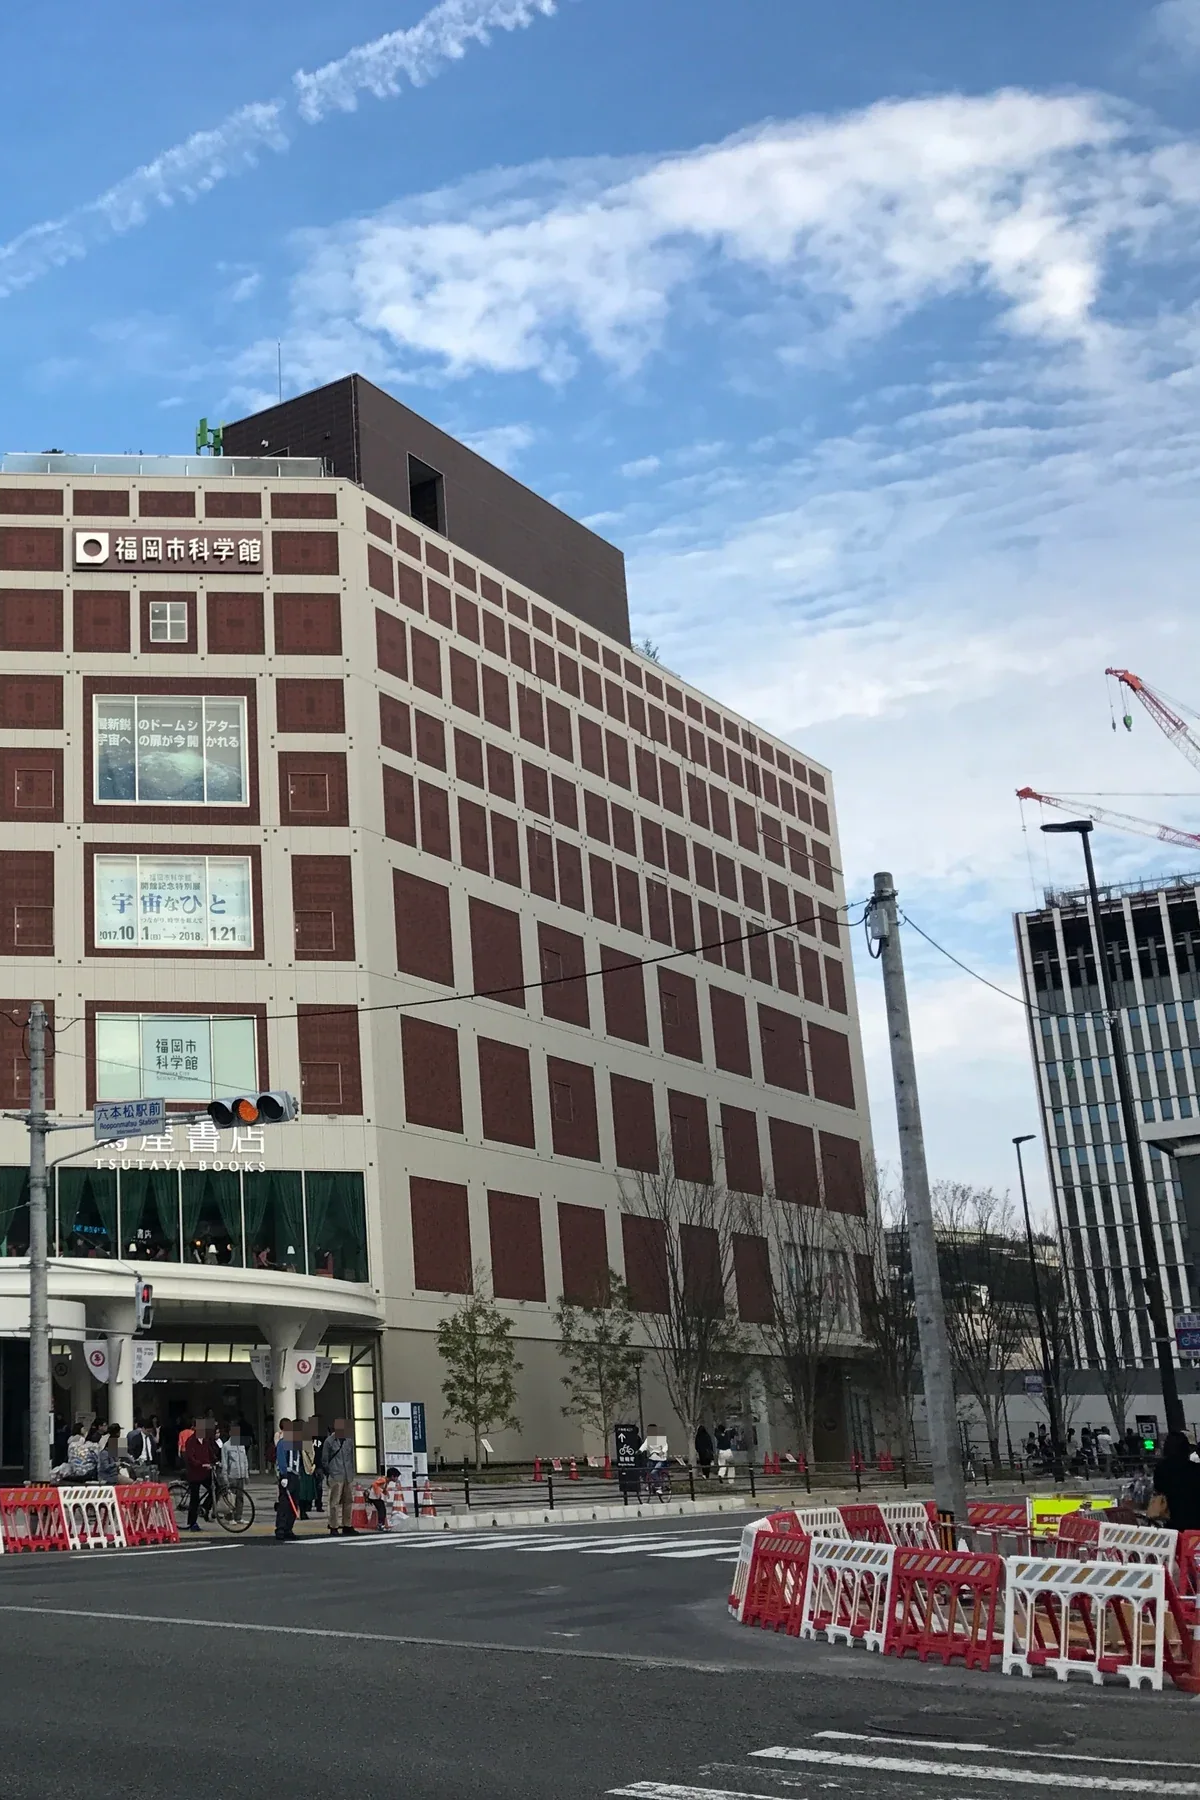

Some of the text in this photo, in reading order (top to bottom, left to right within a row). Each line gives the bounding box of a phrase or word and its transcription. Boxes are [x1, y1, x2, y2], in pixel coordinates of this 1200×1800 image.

[115, 536, 261, 562] 福岡市科学館
[112, 893, 226, 914] 宇宙なひと
[156, 1038, 197, 1054] 福岡市
[156, 1055, 198, 1070] 科学館
[97, 1102, 160, 1121] 六本松駅前
[100, 1118, 159, 1130] Ropponmatsu Station
[94, 1158, 266, 1172] TSUTAYA BOOKS
